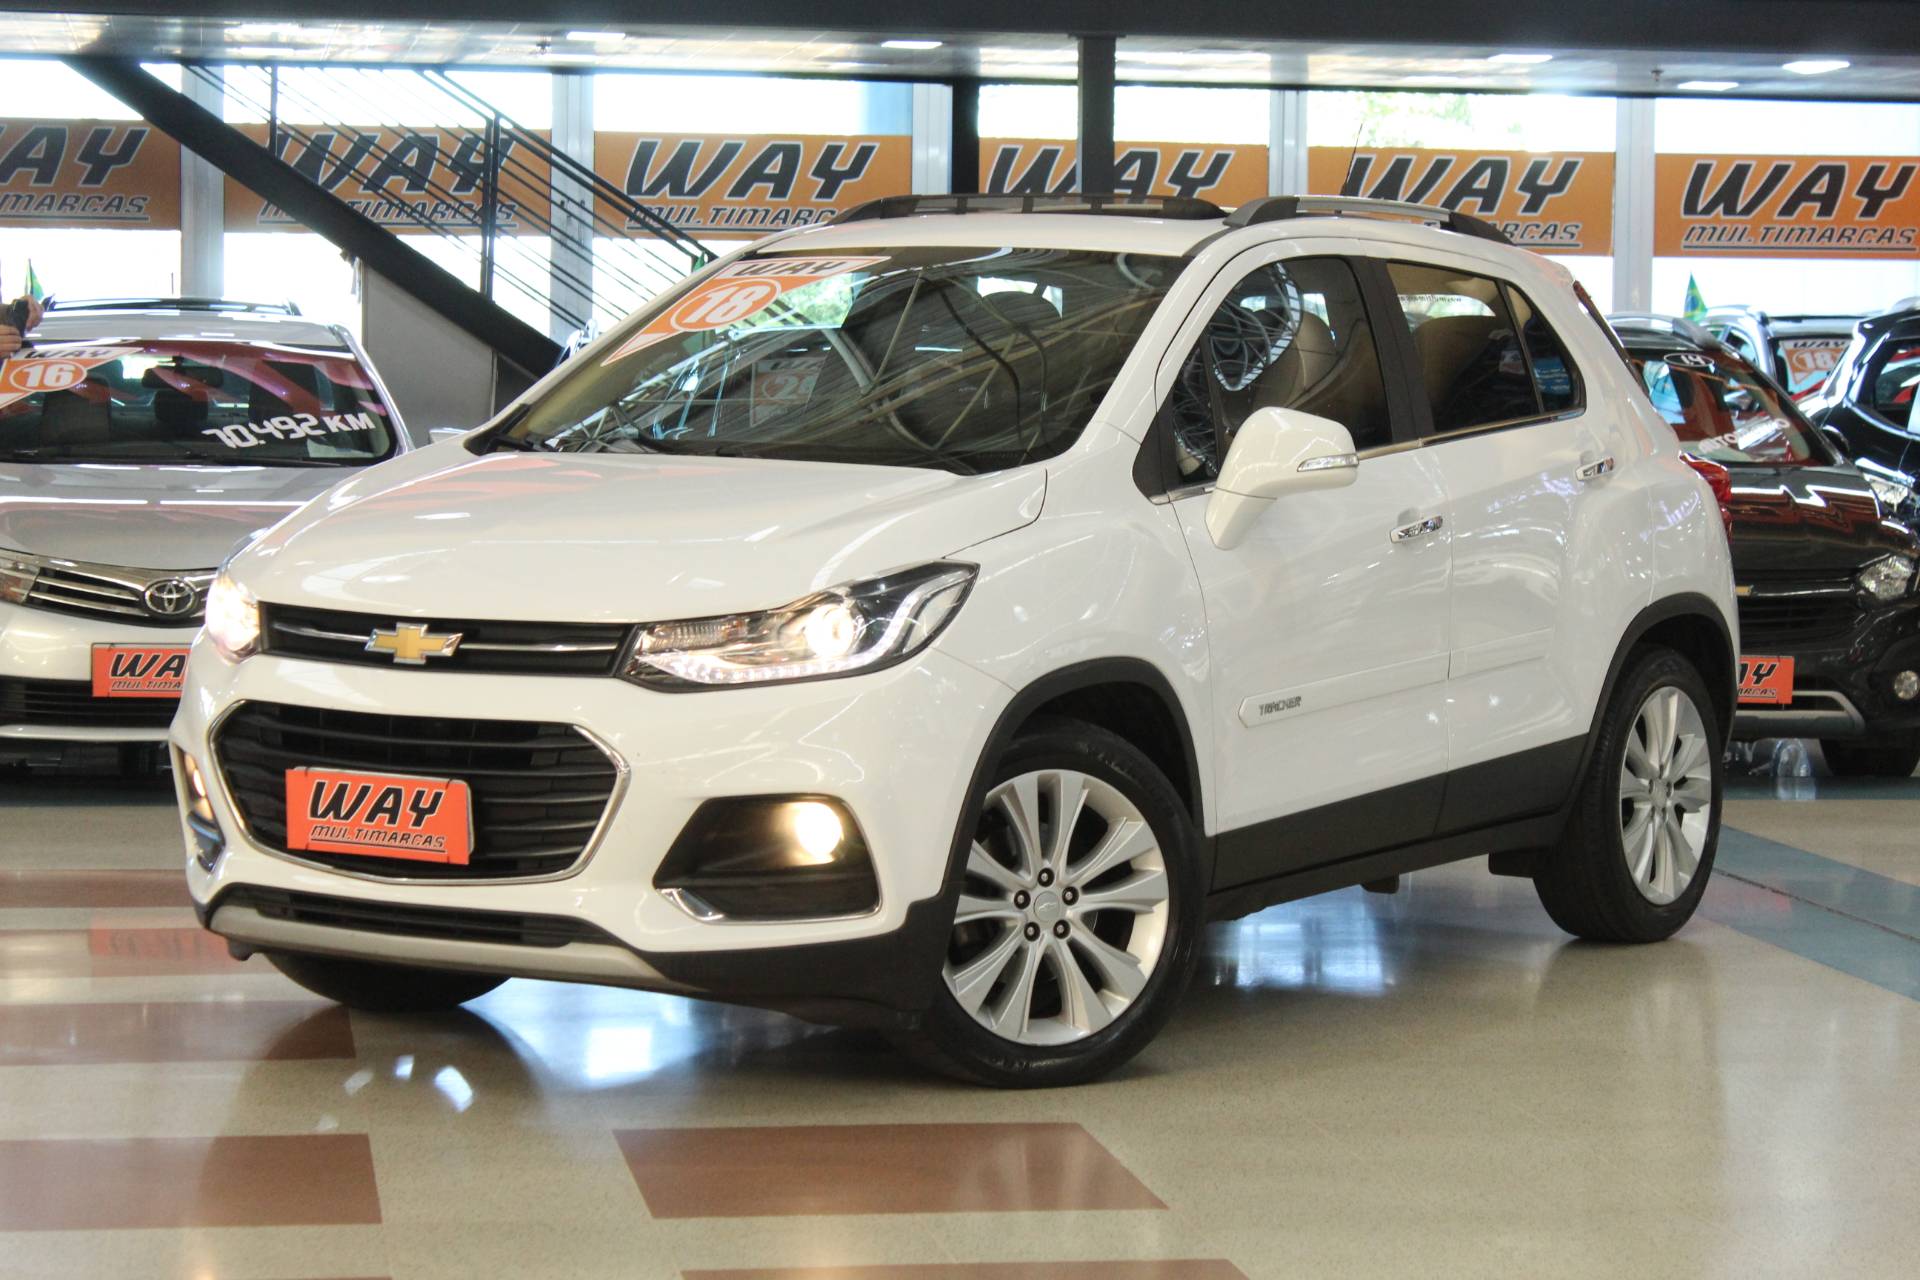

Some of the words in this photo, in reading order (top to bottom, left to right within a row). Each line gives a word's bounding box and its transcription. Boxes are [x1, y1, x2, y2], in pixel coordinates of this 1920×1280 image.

[0, 125, 150, 187] AY
[625, 138, 879, 201] WAY
[984, 144, 1235, 200] WAY
[1341, 154, 1583, 216] WAY
[1680, 160, 1920, 220] WAY
[732, 260, 847, 277] WAY
[682, 285, 772, 323] 18
[22, 363, 76, 387] 16
[1804, 351, 1836, 370] 18
[322, 412, 376, 433] KM
[110, 652, 188, 679] WA
[308, 779, 447, 830] WAY
